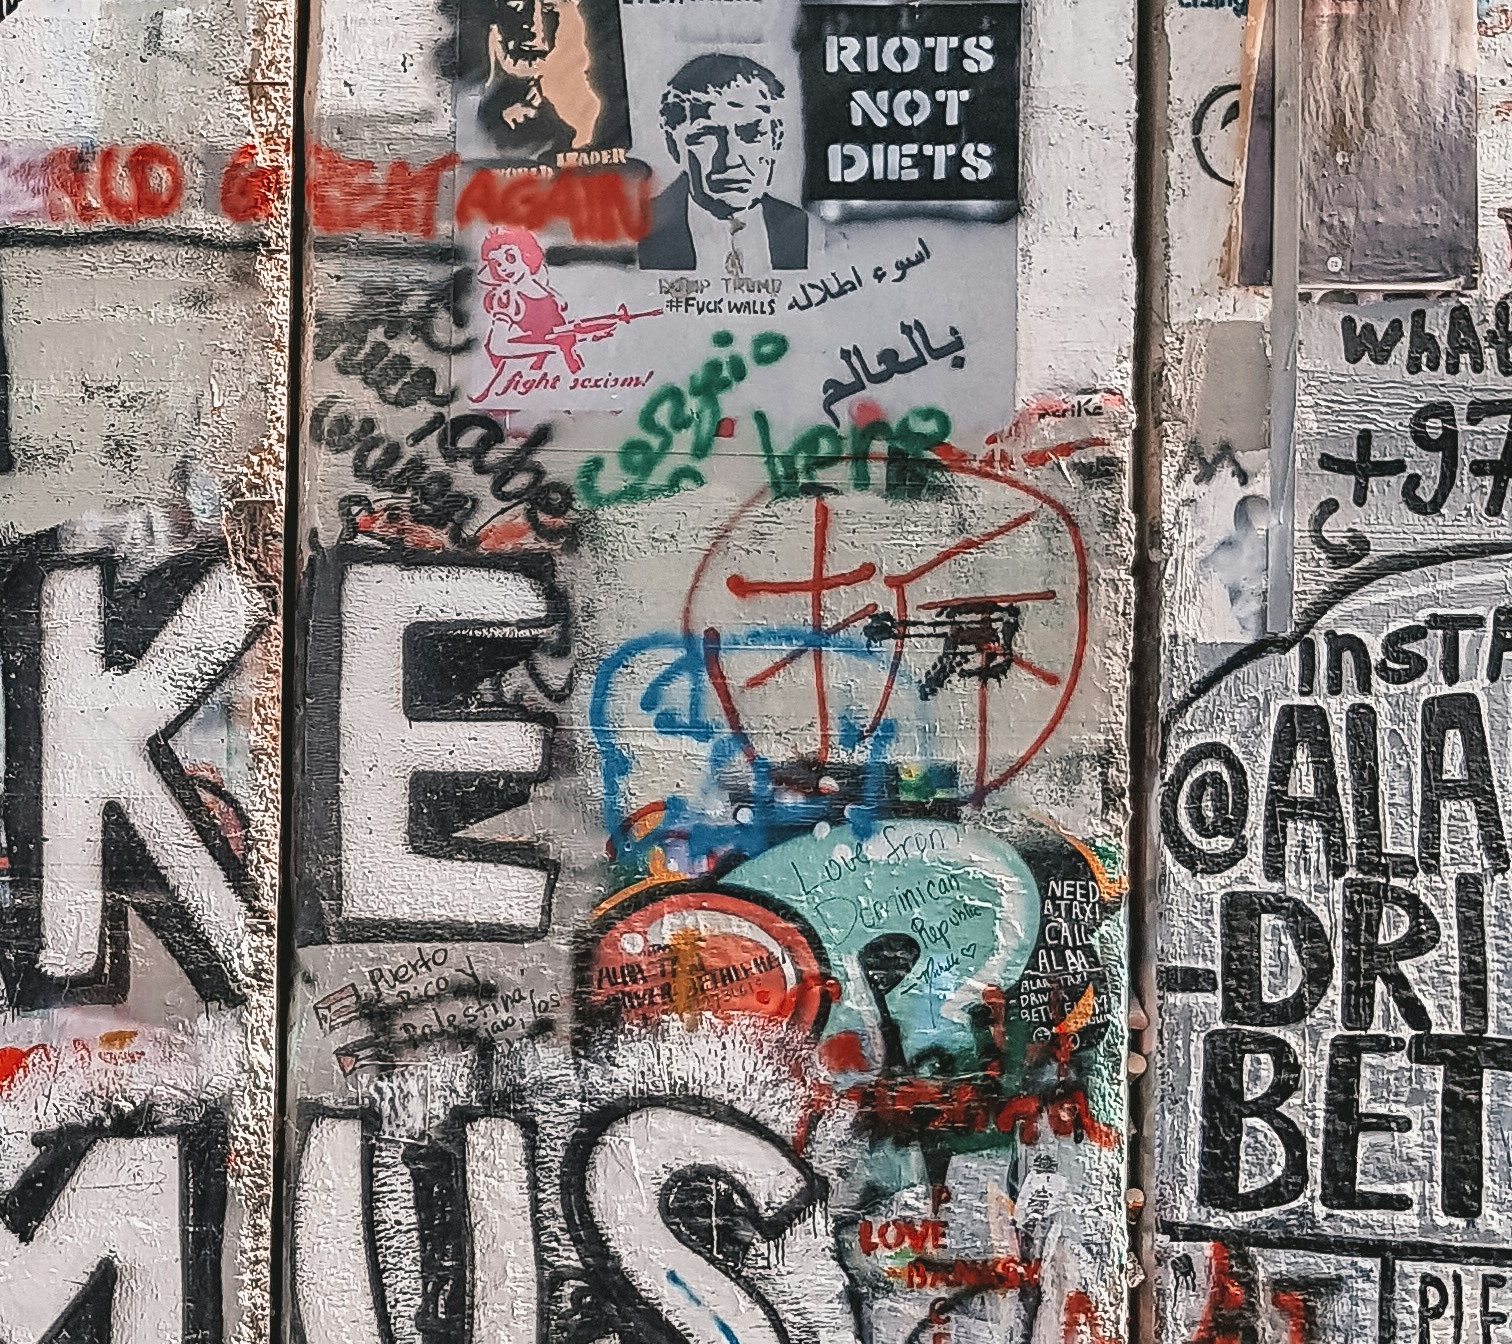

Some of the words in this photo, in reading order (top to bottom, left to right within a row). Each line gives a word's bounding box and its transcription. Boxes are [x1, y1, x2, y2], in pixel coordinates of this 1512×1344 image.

[825, 34, 996, 74] RIOTS
[849, 88, 971, 127] NOT
[827, 142, 994, 183] DIETS
[496, 368, 561, 398] fight
[791, 842, 871, 896] Love
[1048, 879, 1100, 903] NEED
[1055, 900, 1100, 924] TAXI
[1045, 921, 1093, 947] CALL
[368, 946, 448, 997] Puerto
[1196, 1029, 1512, 1220] BET
[859, 1218, 948, 1256] LOVE
